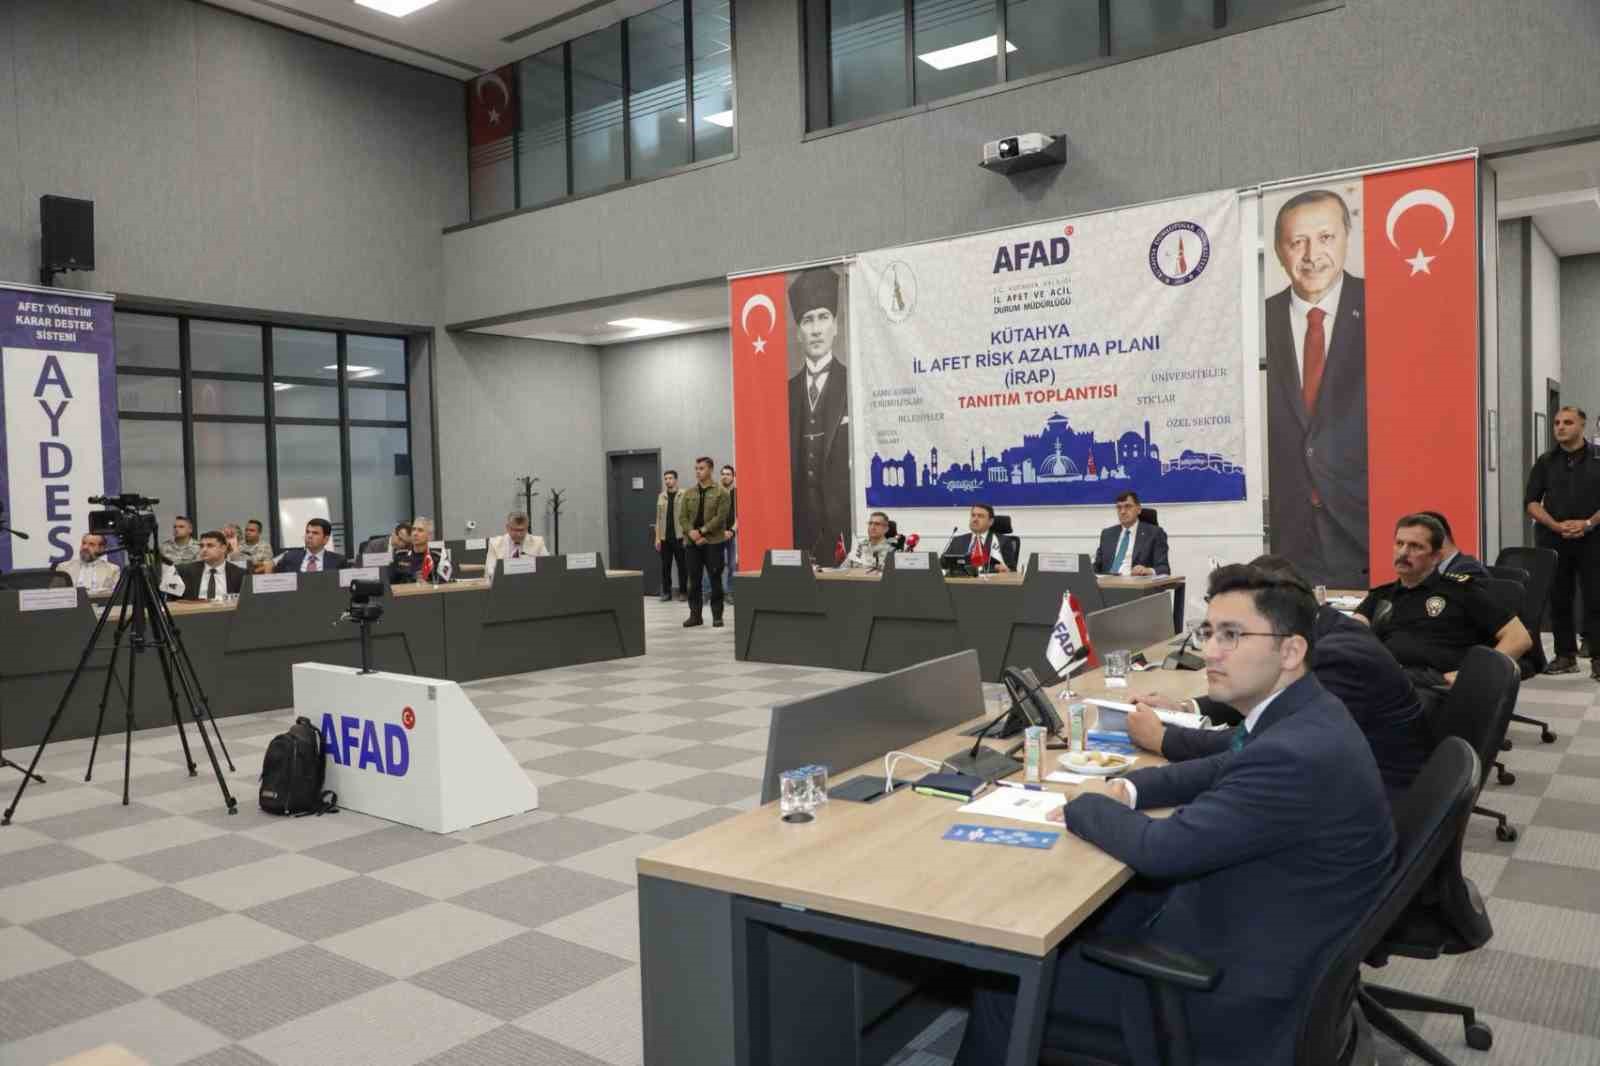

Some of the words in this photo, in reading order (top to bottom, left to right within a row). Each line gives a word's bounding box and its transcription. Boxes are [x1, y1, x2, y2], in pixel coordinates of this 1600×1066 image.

[992, 236, 1070, 274] AFAD
[18, 301, 45, 313] AFET
[47, 303, 92, 317] YÖNETİM
[993, 303, 1021, 315] DURUM
[15, 315, 52, 328] KARAR
[54, 318, 95, 331] DESTEK
[36, 328, 77, 342] SİSTEMİ
[991, 323, 1070, 345] KÜTAHYA
[913, 357, 926, 374] İL
[930, 355, 970, 373] AFET
[975, 350, 1014, 368] RİSK
[1018, 341, 1100, 363] AZALTMA
[1105, 335, 1160, 355] PLANI
[1004, 367, 1056, 389] (İRAP)
[958, 391, 1020, 409] TANITIM
[1024, 383, 1118, 404] TOPLANTISI
[33, 354, 74, 564] AYDES
[1049, 621, 1074, 657] FAD
[320, 712, 410, 777] AFAD
